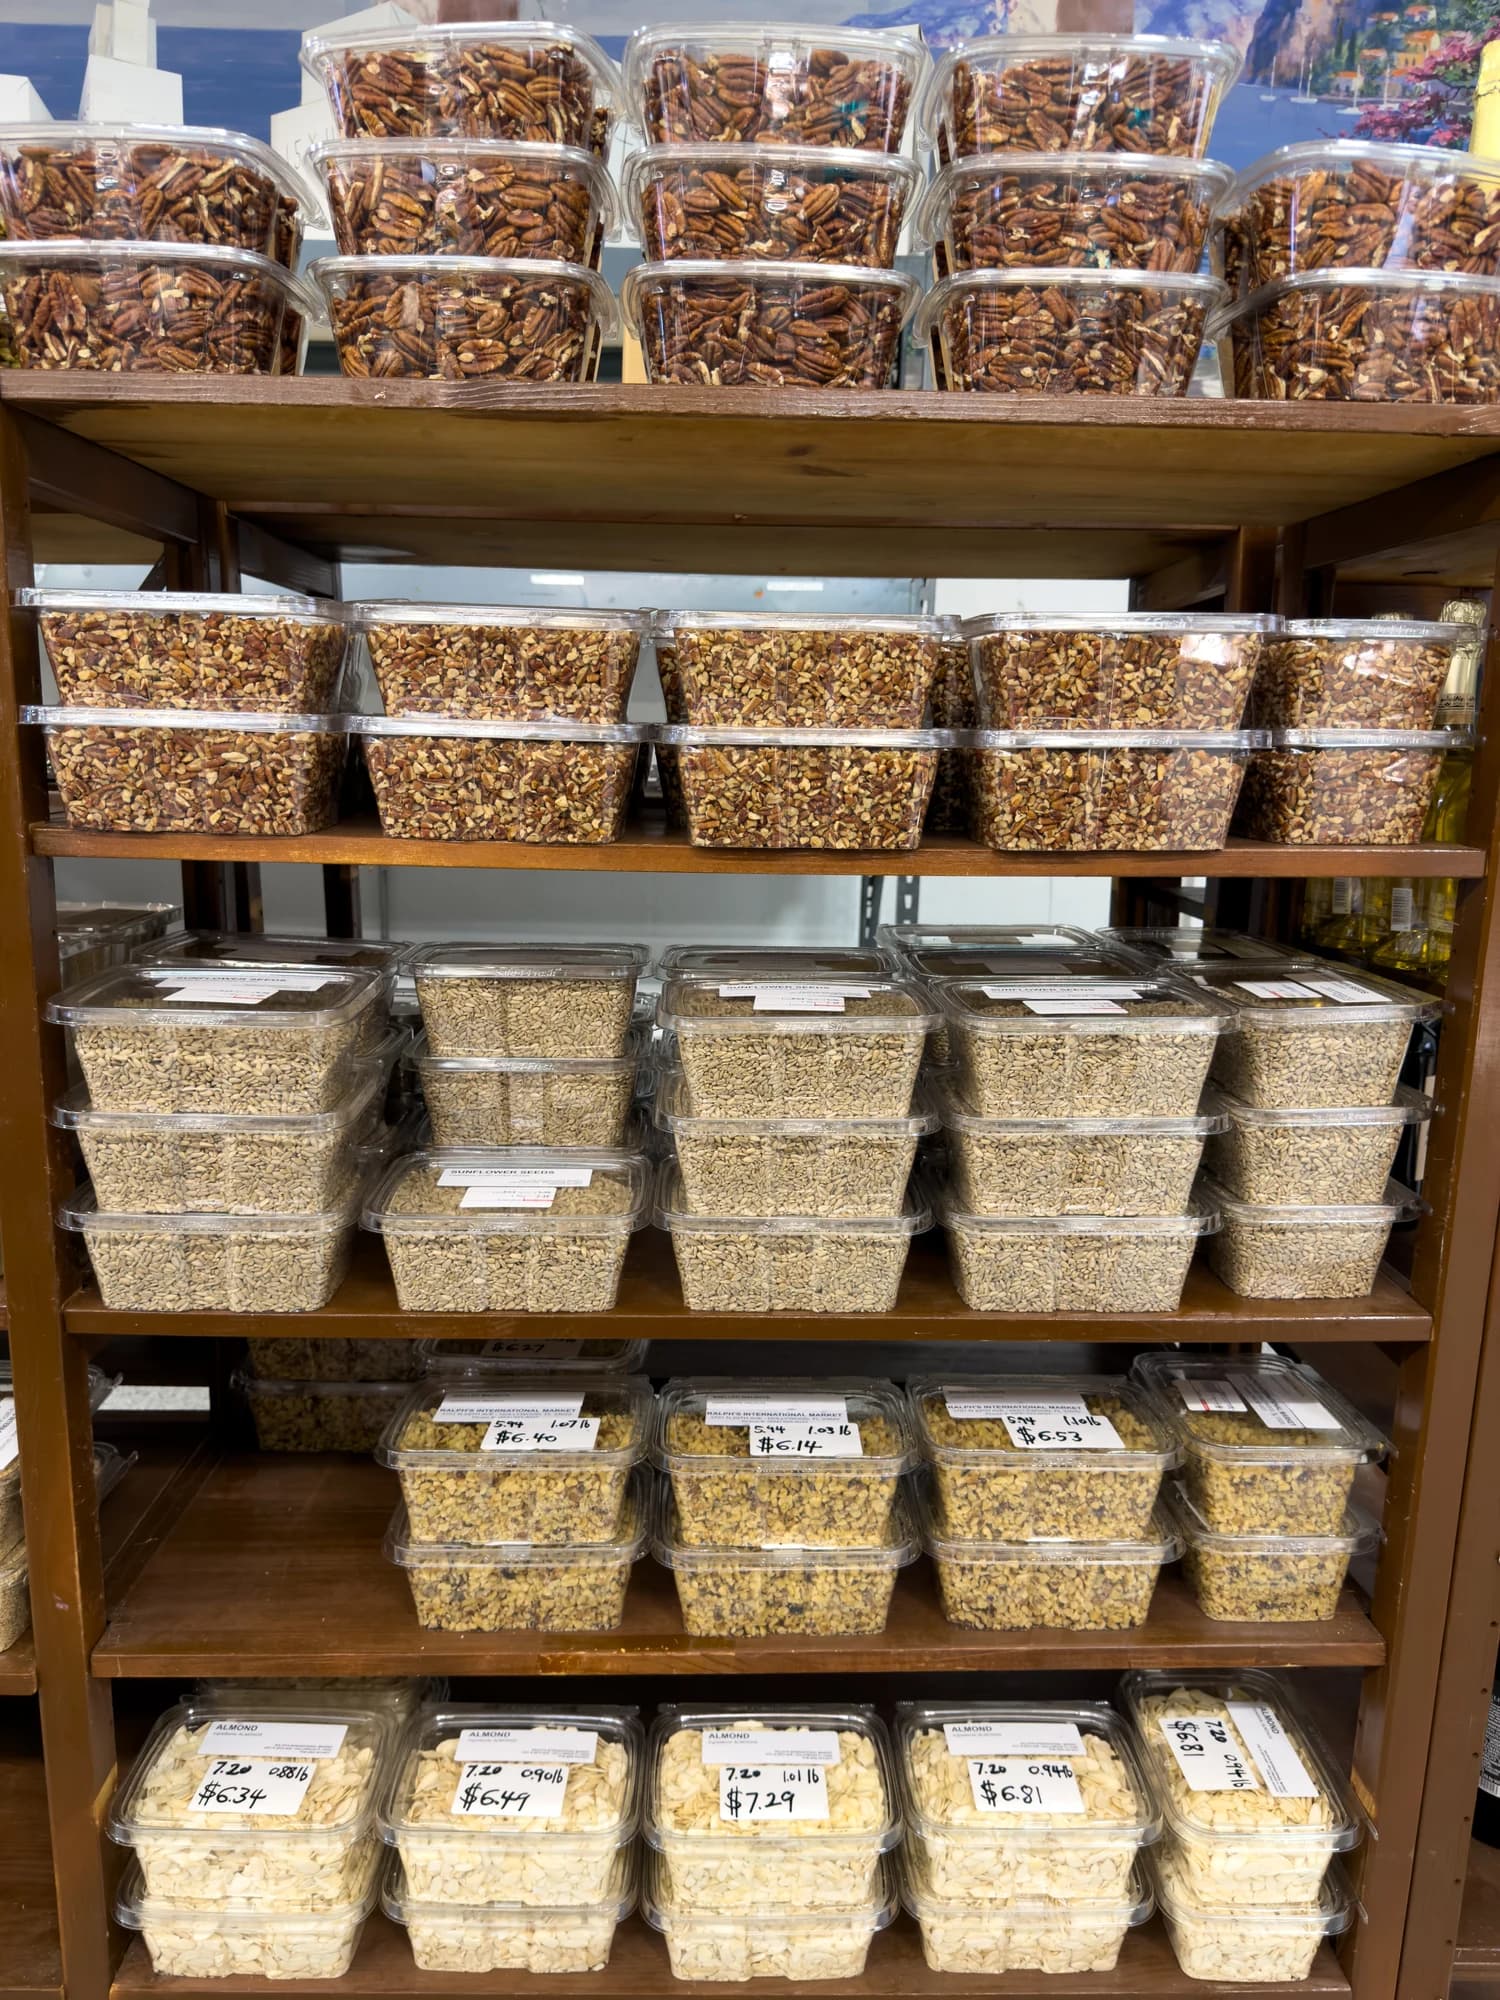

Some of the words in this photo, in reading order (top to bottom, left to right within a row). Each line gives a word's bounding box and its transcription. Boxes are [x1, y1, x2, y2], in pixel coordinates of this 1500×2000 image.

[495, 1431, 557, 1445] $6.40
[756, 1436, 822, 1453] $6.14
[1016, 1426, 1083, 1446] $6.53
[216, 1724, 258, 1732] ALMOND
[1261, 1706, 1279, 1735] ALMOND
[1166, 1720, 1205, 1757] $6.81
[212, 1761, 252, 1776] 7.20
[465, 1765, 502, 1778] 7.20
[725, 1767, 761, 1781] 7.20
[972, 1762, 1007, 1775] 7.20
[198, 1780, 267, 1809] $6.34
[459, 1781, 531, 1812] $6.49
[724, 1785, 796, 1818] $7.29
[980, 1779, 1043, 1808] $6.81
